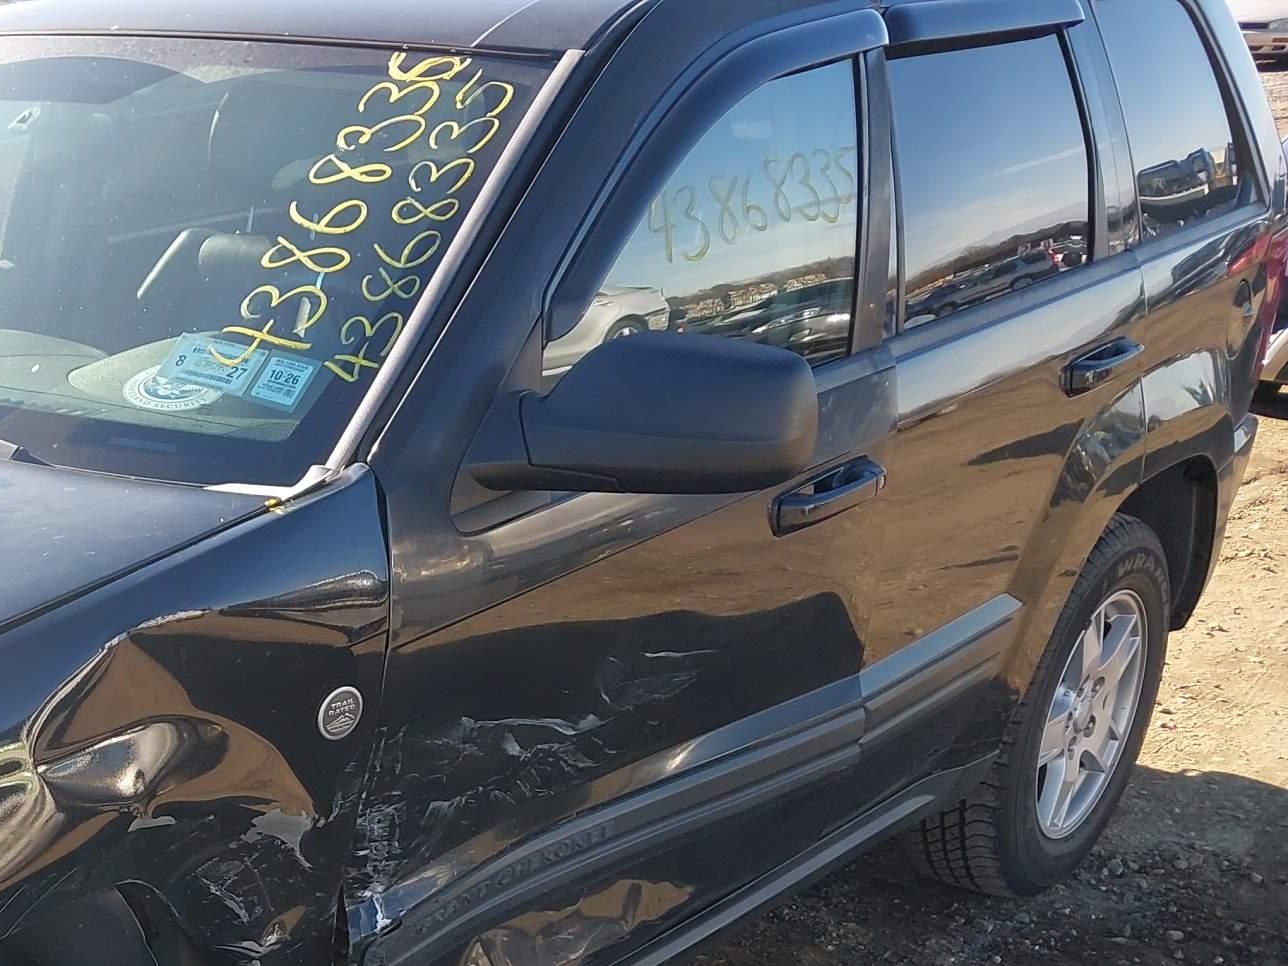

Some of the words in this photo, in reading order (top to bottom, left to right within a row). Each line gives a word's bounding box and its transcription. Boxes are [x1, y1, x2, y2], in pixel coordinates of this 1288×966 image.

[647, 144, 856, 265] 43868335
[323, 68, 515, 383] 43868335
[175, 354, 188, 367] 8
[226, 366, 248, 380] 27
[328, 704, 356, 717] RATED
[330, 698, 355, 710] TRAIL
